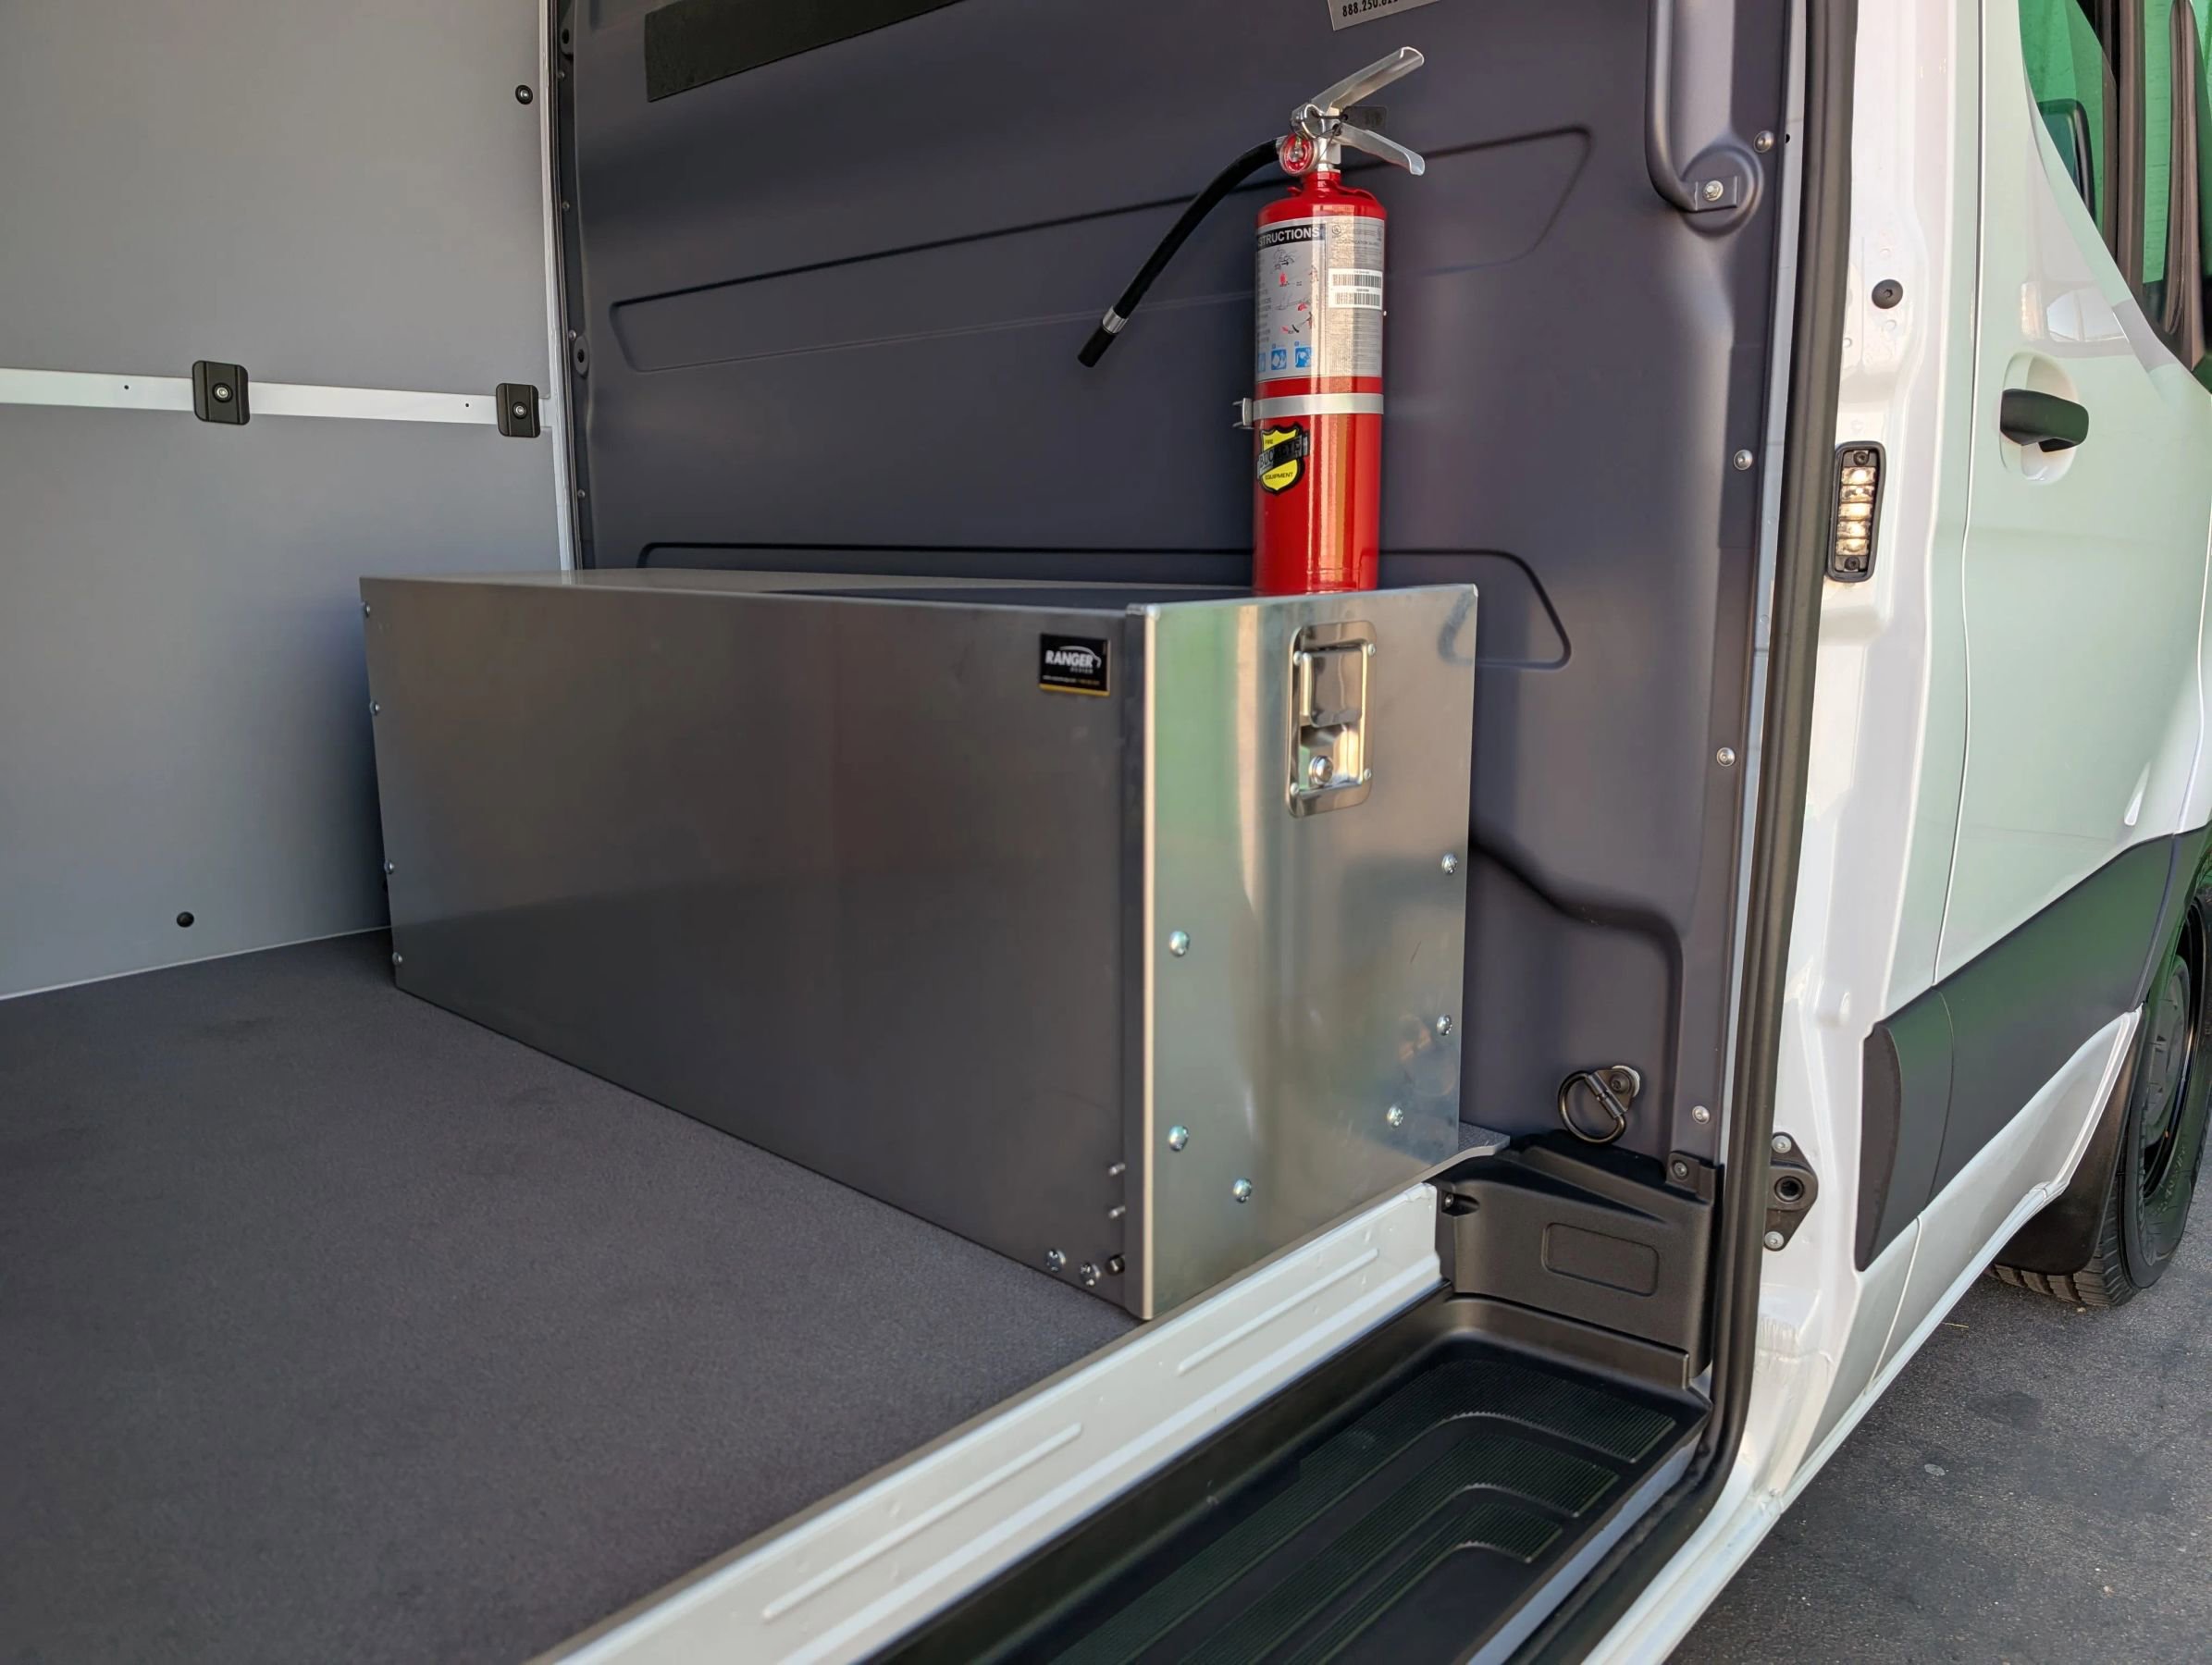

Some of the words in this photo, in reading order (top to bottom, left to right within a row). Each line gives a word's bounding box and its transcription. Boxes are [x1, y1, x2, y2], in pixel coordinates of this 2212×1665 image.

[1259, 439, 1300, 468] BUCKEYE
[1265, 472, 1293, 480] EQUIPMENT
[1044, 649, 1094, 667] RANGER
